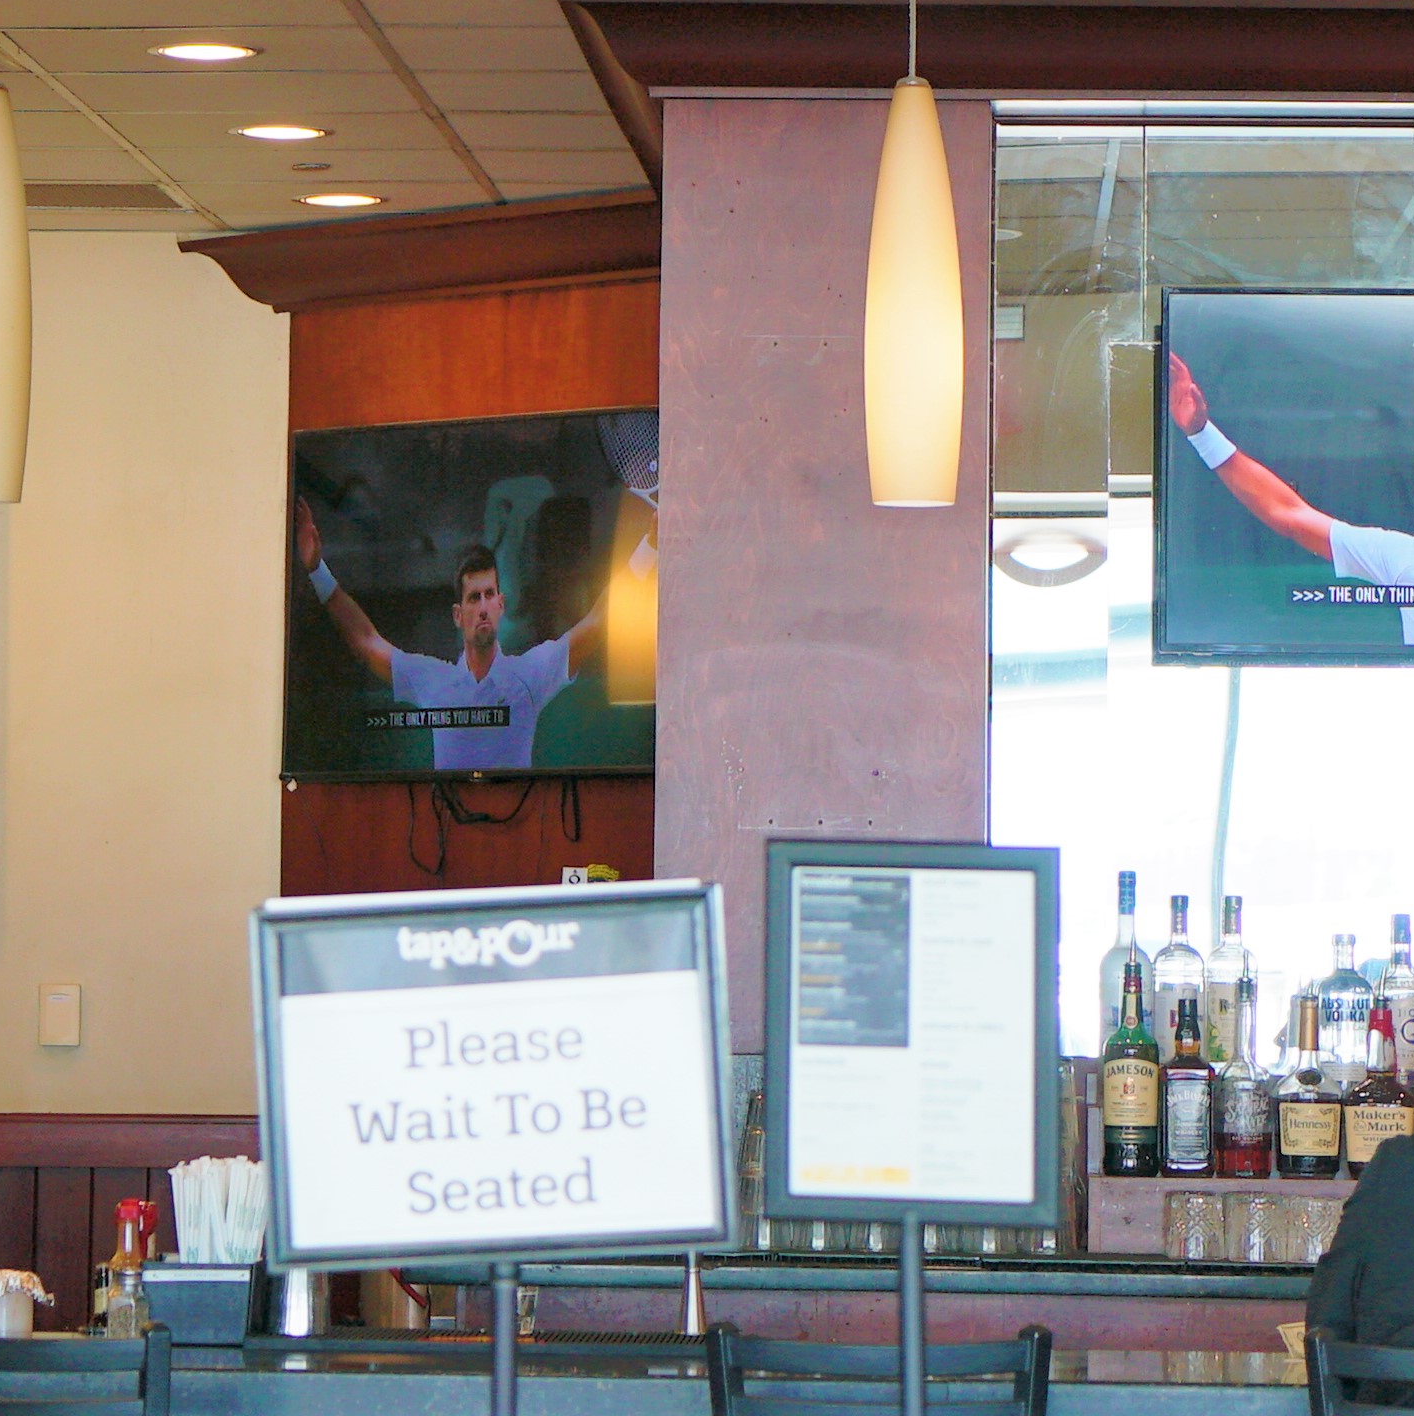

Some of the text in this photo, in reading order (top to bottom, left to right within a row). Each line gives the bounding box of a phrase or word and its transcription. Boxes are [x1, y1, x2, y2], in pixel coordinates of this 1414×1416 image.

[1328, 586, 1353, 603] THE
[1355, 586, 1386, 603] ONLY
[389, 712, 405, 726] THE
[406, 711, 426, 726] ONLY
[427, 711, 452, 726] THING
[453, 710, 469, 725] YOU
[470, 710, 492, 725] HAVE
[493, 709, 504, 724] TO
[1321, 997, 1371, 1010] ABSLUT
[403, 1020, 583, 1069] Please
[1105, 1063, 1155, 1079] JAMESON
[349, 1088, 647, 1144] Wait To Be
[1353, 1110, 1407, 1121] Maker's
[1289, 1117, 1332, 1131] Hennessy
[1367, 1122, 1407, 1132] Mark
[407, 1156, 597, 1214] Seated
